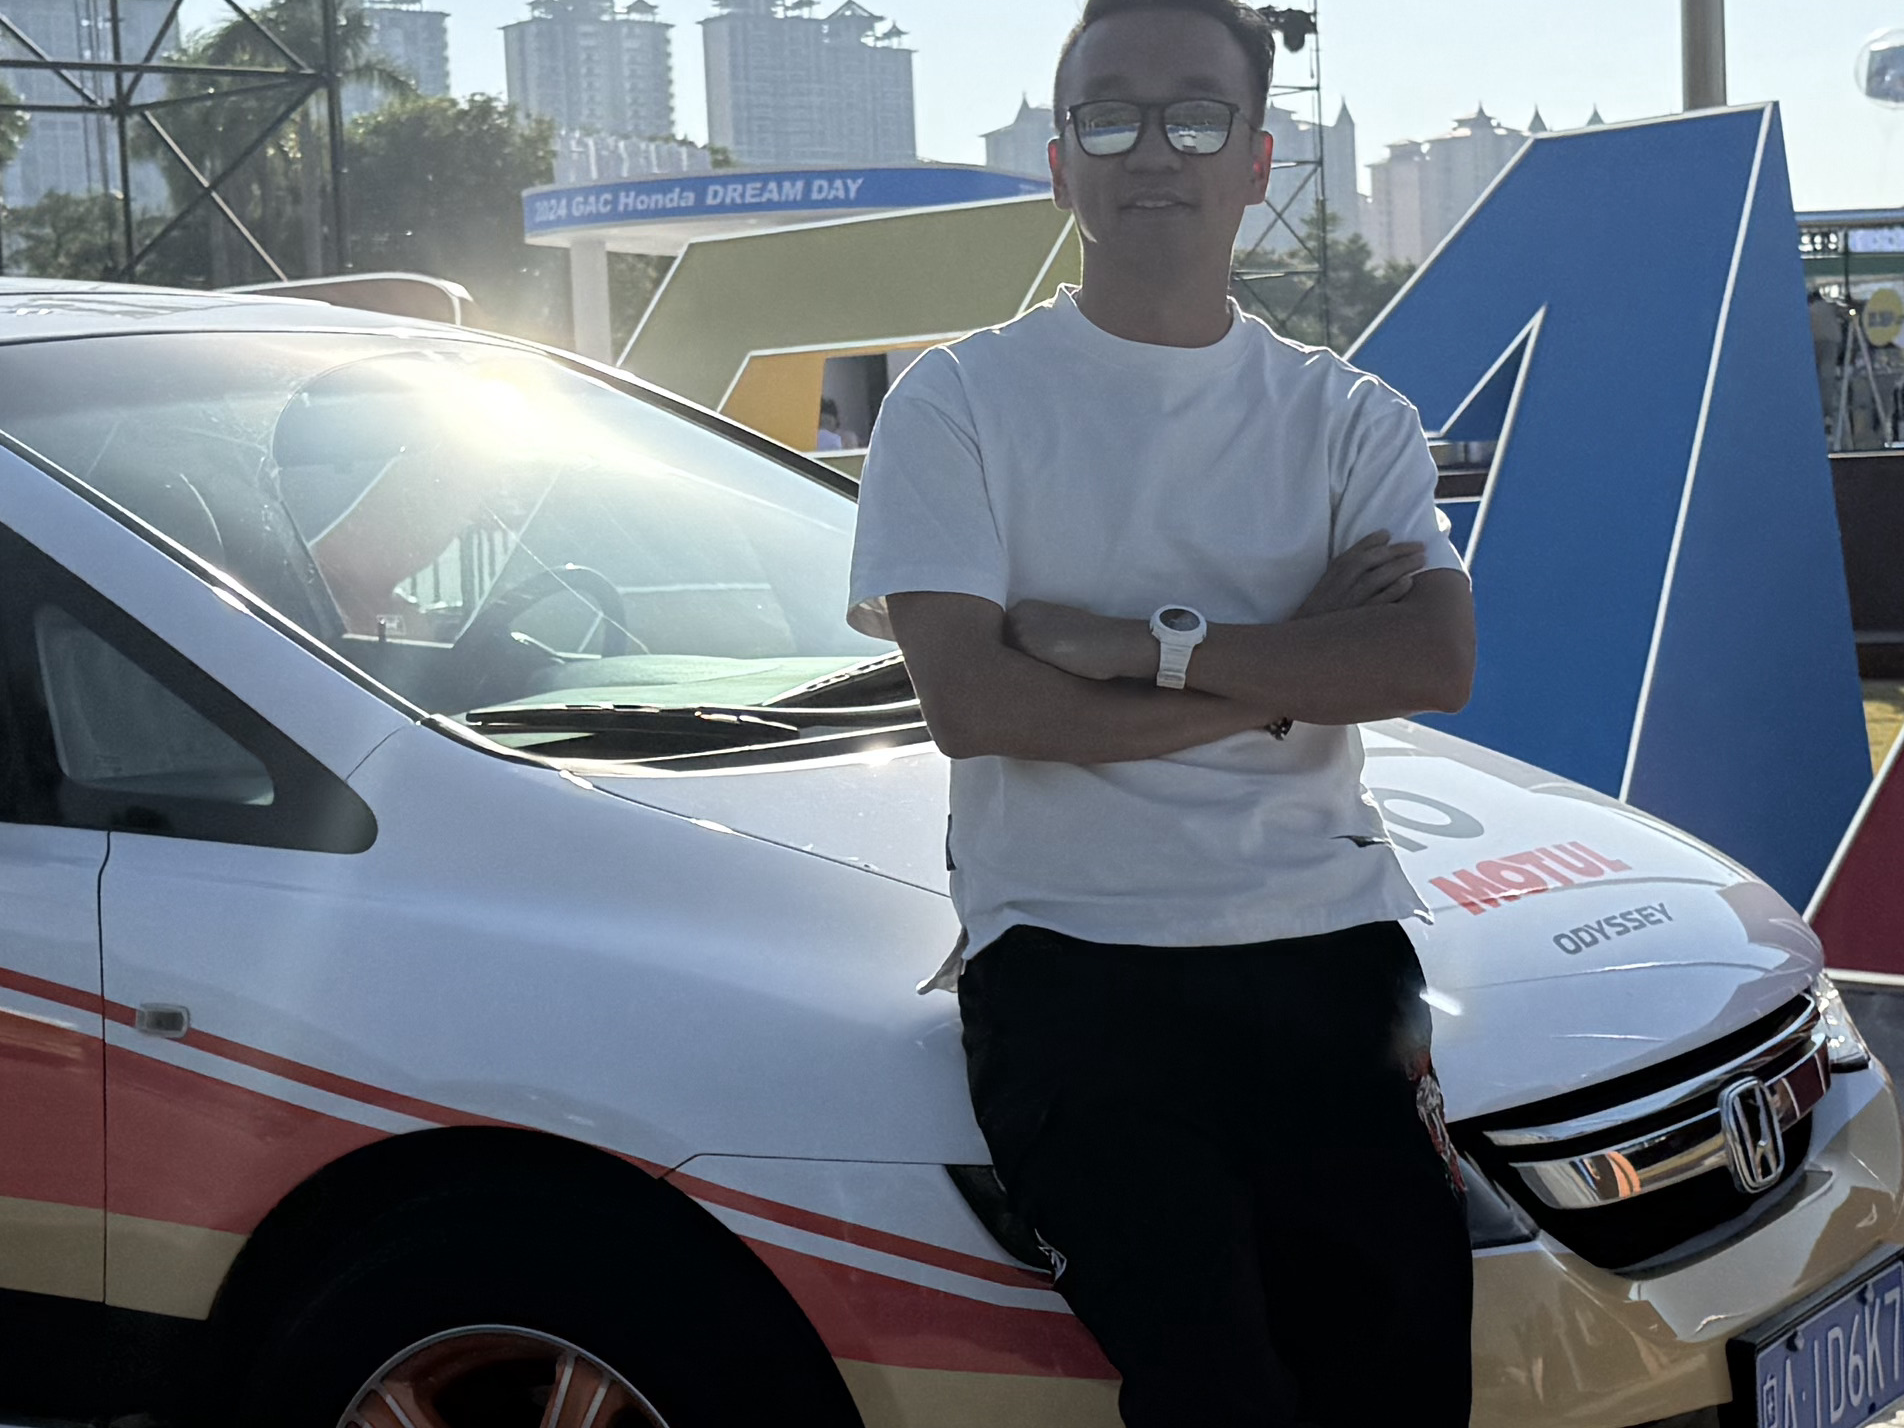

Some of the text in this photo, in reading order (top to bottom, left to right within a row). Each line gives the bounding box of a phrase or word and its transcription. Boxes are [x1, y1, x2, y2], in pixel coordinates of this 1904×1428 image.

[571, 193, 612, 217] GAC
[617, 187, 696, 213] Honda
[705, 178, 805, 206] DREAM
[810, 177, 865, 201] DAY
[1428, 840, 1633, 916] MOTUL
[1552, 902, 1675, 956] ODYSSEY
